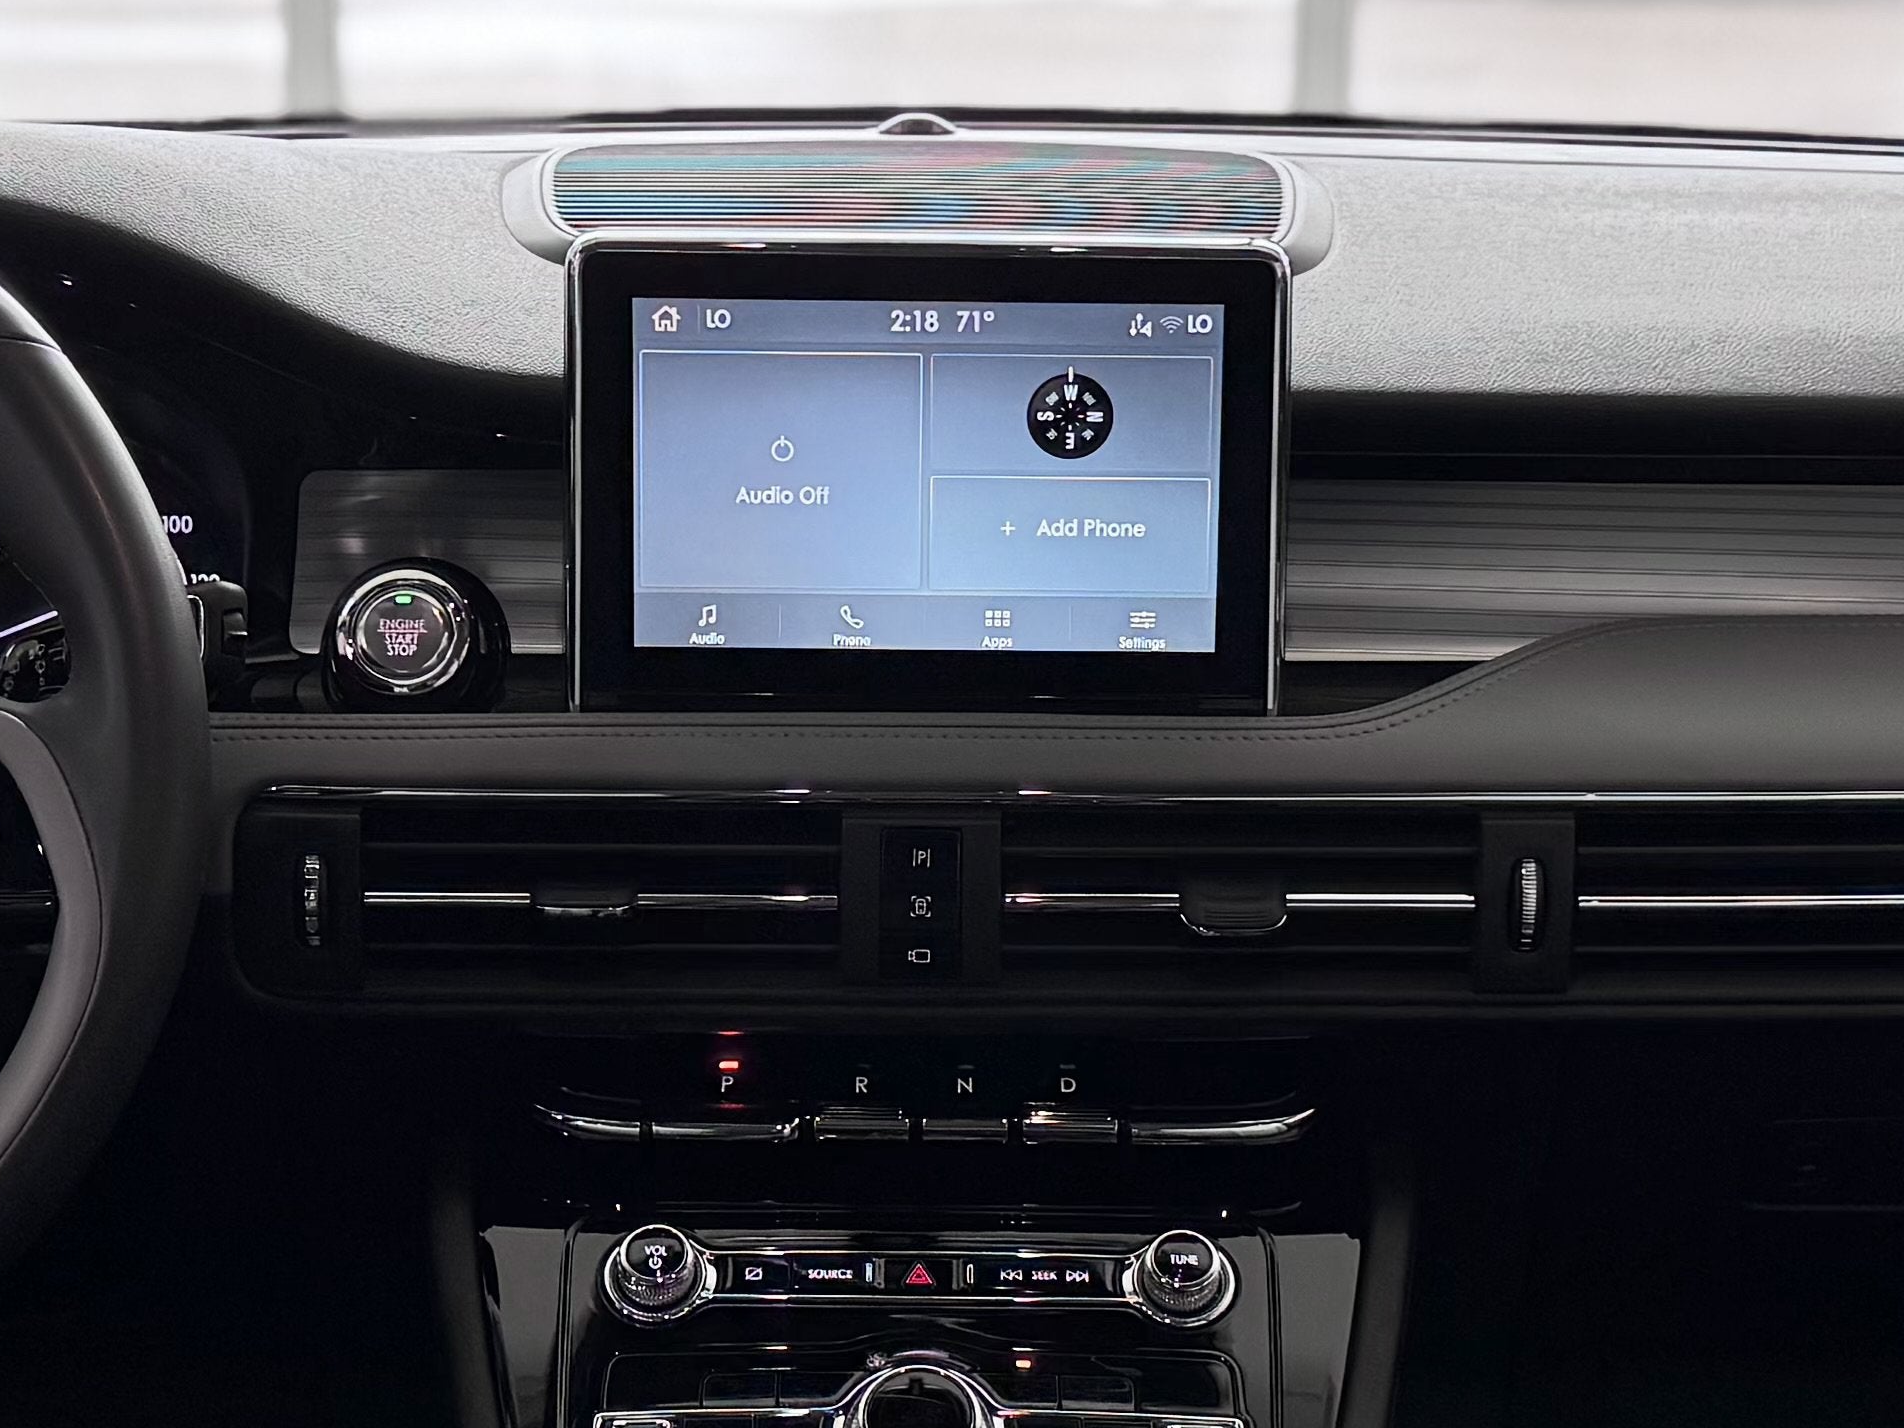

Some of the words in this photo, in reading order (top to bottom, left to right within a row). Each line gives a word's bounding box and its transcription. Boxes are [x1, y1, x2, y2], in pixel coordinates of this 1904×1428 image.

[706, 309, 731, 330] LO
[890, 310, 939, 335] 2:18
[956, 311, 995, 334] 71°
[1188, 314, 1212, 335] LO
[1063, 384, 1078, 401] W
[735, 485, 793, 505] Audio
[799, 486, 830, 505] Off
[161, 515, 193, 533] 100
[1036, 517, 1078, 538] Add
[1084, 518, 1146, 538] Phone
[379, 618, 425, 631] ENGINE
[384, 633, 420, 645] START
[689, 632, 725, 646] Audio
[833, 633, 871, 648] Phone
[981, 635, 1013, 649] Apps
[1118, 634, 1166, 652] Settings
[386, 644, 417, 656] STOP
[721, 1076, 734, 1093] P
[856, 1077, 868, 1093] R
[957, 1077, 973, 1093] N
[1061, 1077, 1076, 1093] D
[645, 1245, 667, 1256] VOL
[1170, 1254, 1199, 1266] TUNE
[808, 1268, 853, 1280] SOURCE
[1032, 1270, 1058, 1281] SEEK
